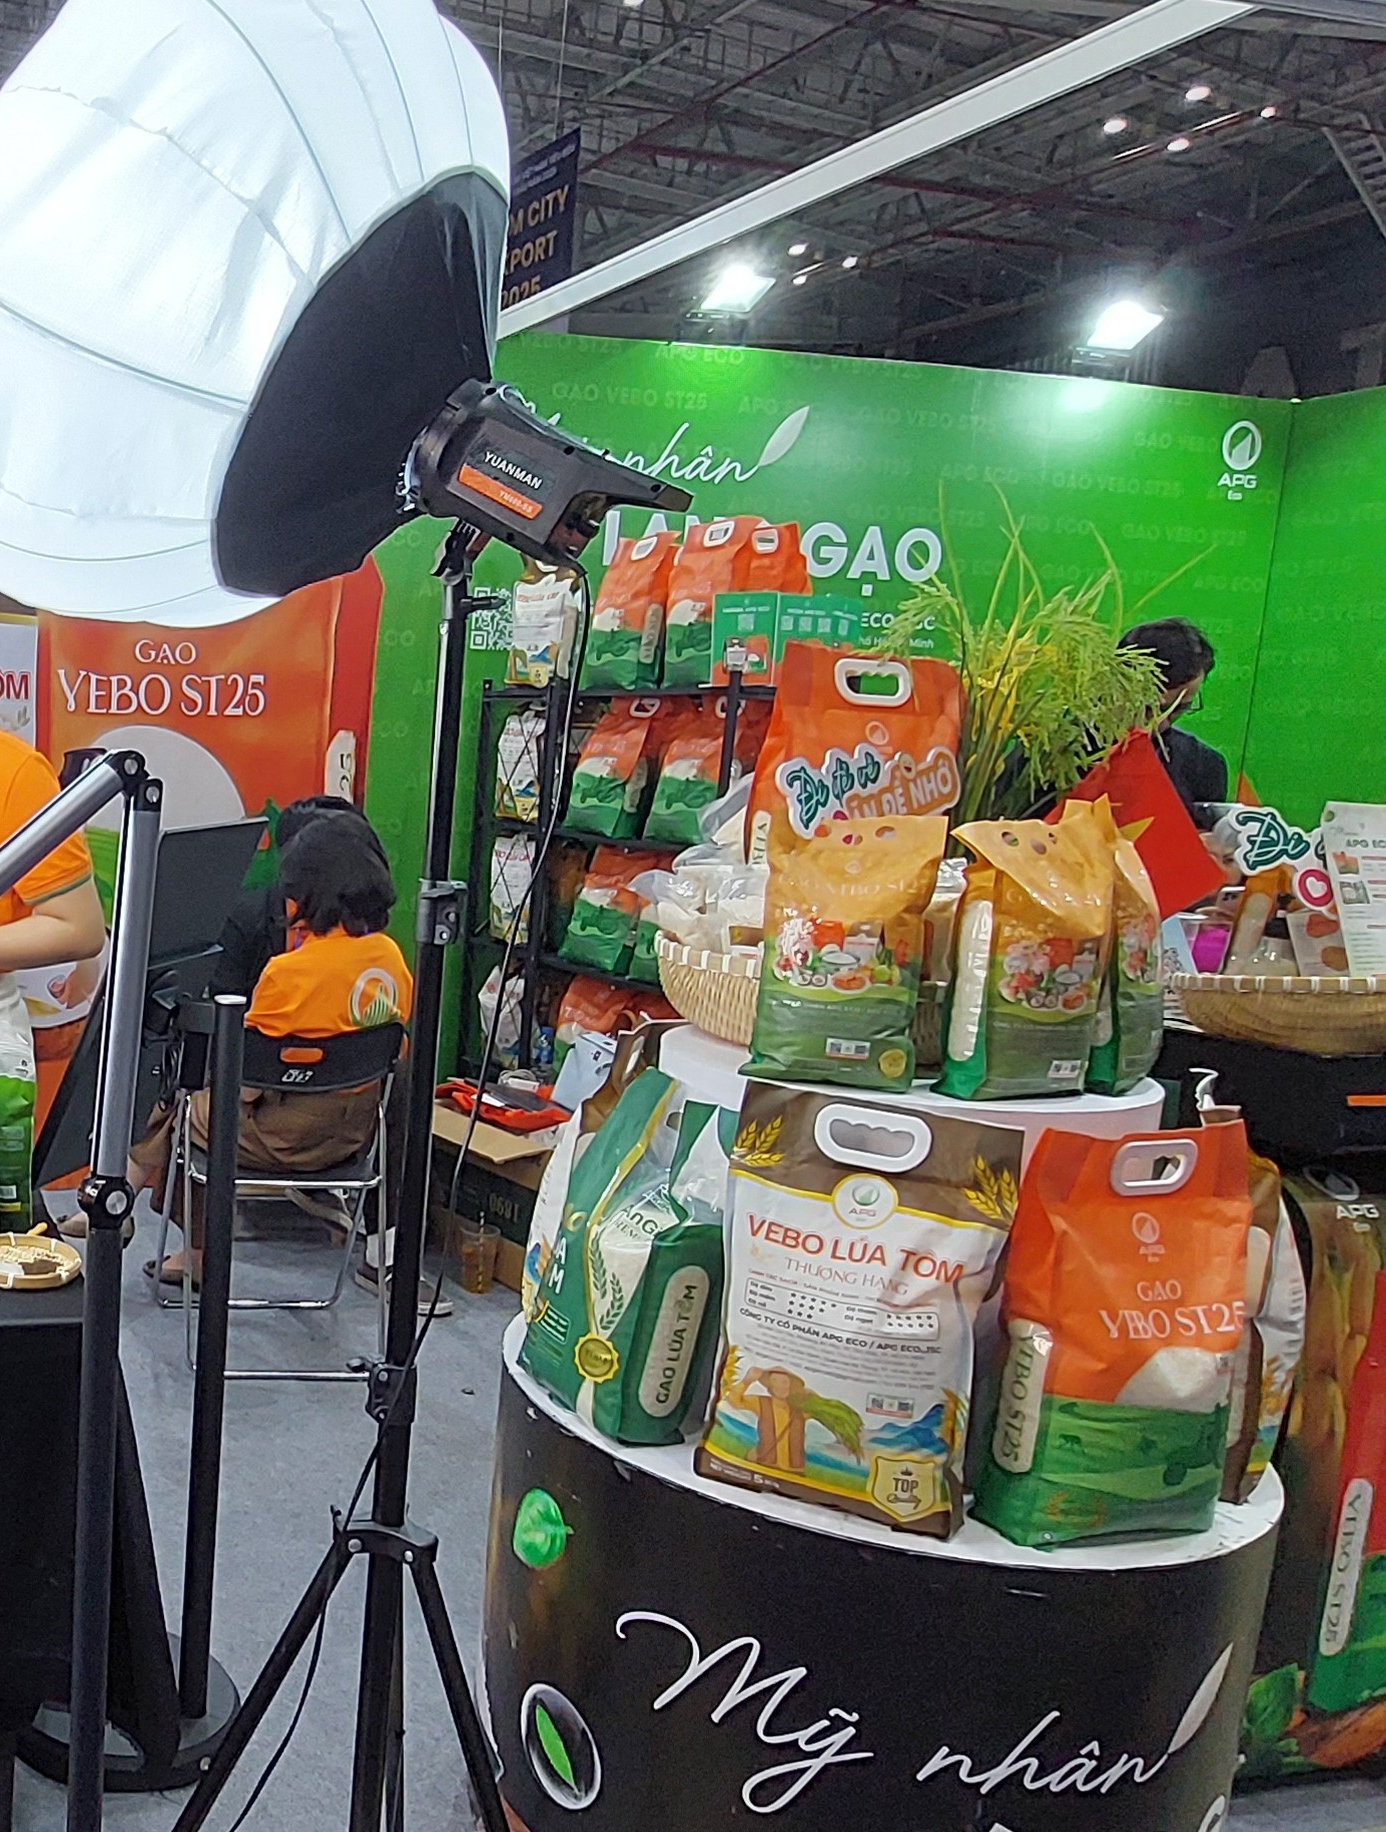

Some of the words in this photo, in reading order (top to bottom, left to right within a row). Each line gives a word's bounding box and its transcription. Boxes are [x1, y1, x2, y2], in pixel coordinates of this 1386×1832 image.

[527, 184, 569, 228] CITY
[505, 229, 558, 276] PORT
[703, 349, 745, 365] ECO
[484, 451, 543, 489] YUANMAN
[1217, 471, 1258, 490] APG
[801, 521, 943, 598] GẠO
[57, 668, 171, 717] VEBO
[180, 673, 265, 717] ST25
[338, 751, 354, 792] 25
[1235, 810, 1311, 871] Đi
[1336, 1203, 1380, 1220] APG
[747, 1213, 824, 1256] VEBO
[830, 1233, 887, 1268] LÚA
[899, 1244, 965, 1286] TÔM
[739, 1307, 762, 1321] CÔNG
[764, 1315, 775, 1325] TY
[845, 1337, 868, 1348] ECO
[1002, 1406, 1027, 1463] ST25
[892, 1477, 919, 1493] TOP
[616, 1610, 874, 1813] Mỹ
[916, 1709, 1170, 1794] nhân
